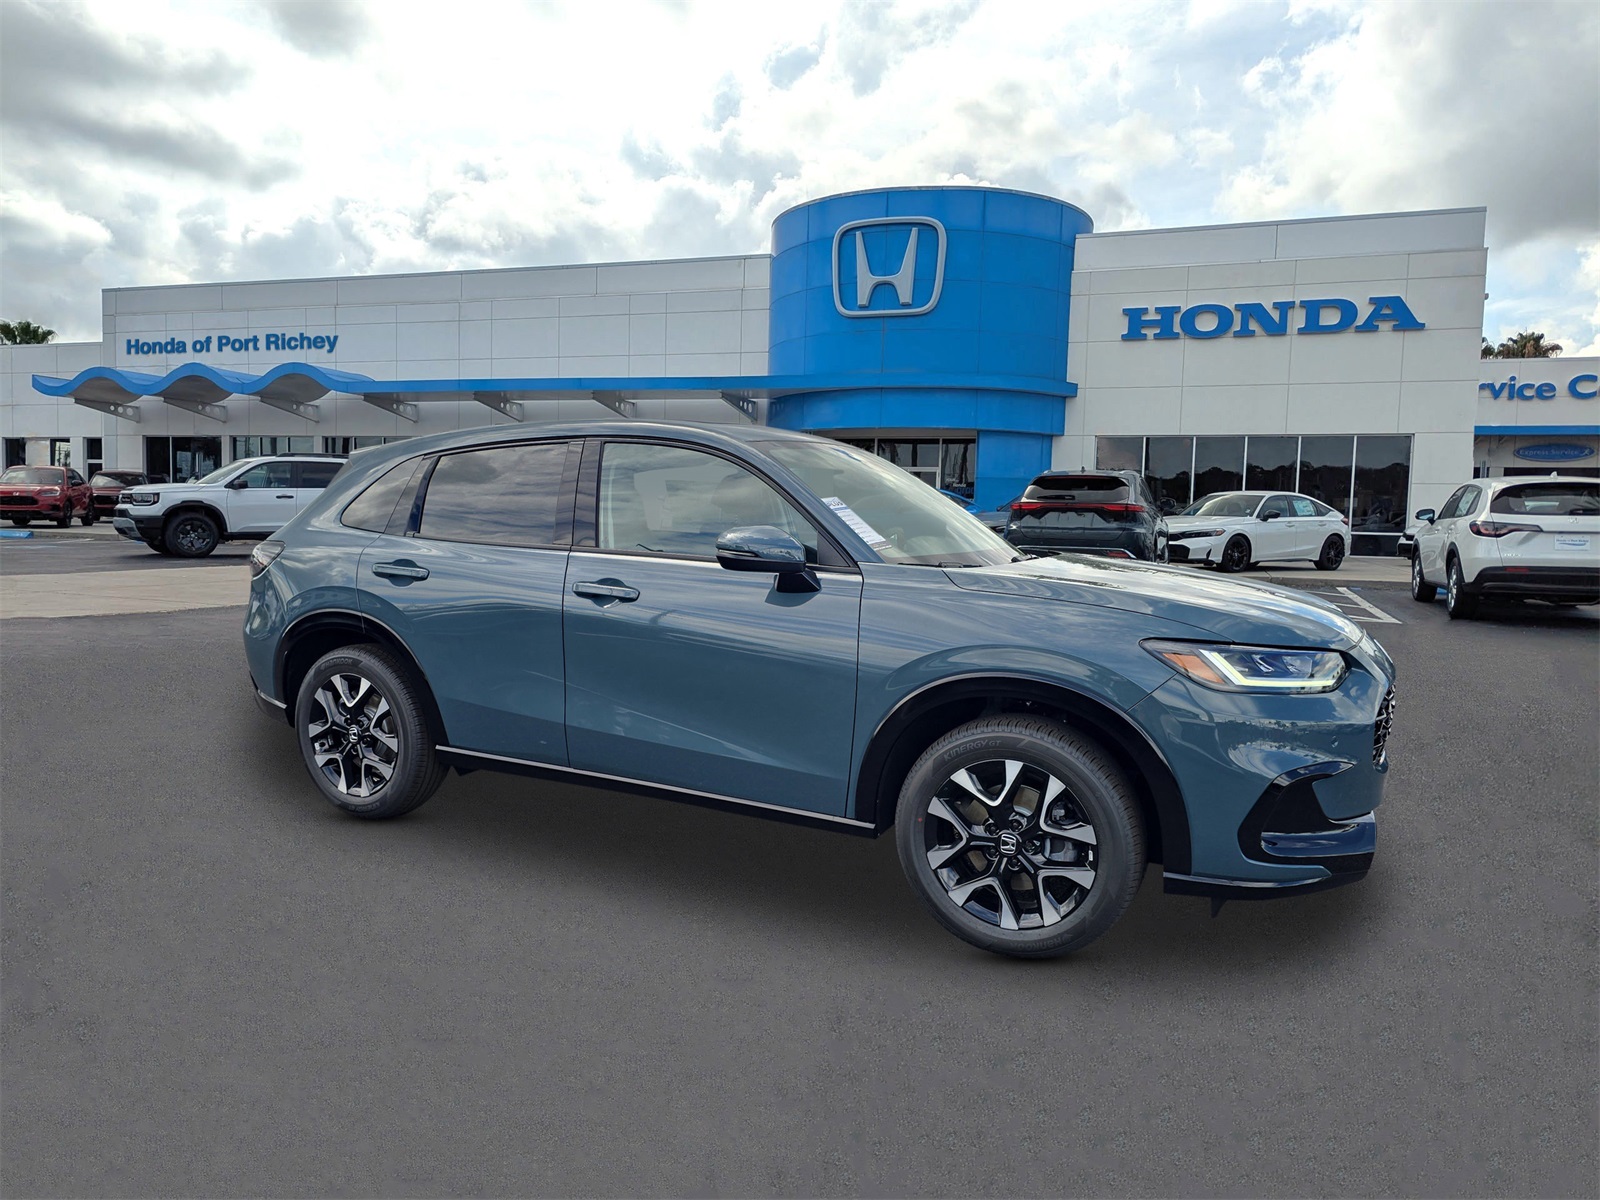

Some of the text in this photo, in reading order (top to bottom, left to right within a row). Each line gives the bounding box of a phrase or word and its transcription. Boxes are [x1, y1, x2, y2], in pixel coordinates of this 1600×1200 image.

[1121, 295, 1426, 341] HONDA
[126, 332, 339, 355] Honda of Port Richey
[1567, 373, 1600, 401] C
[1519, 447, 1580, 457] Express Service
